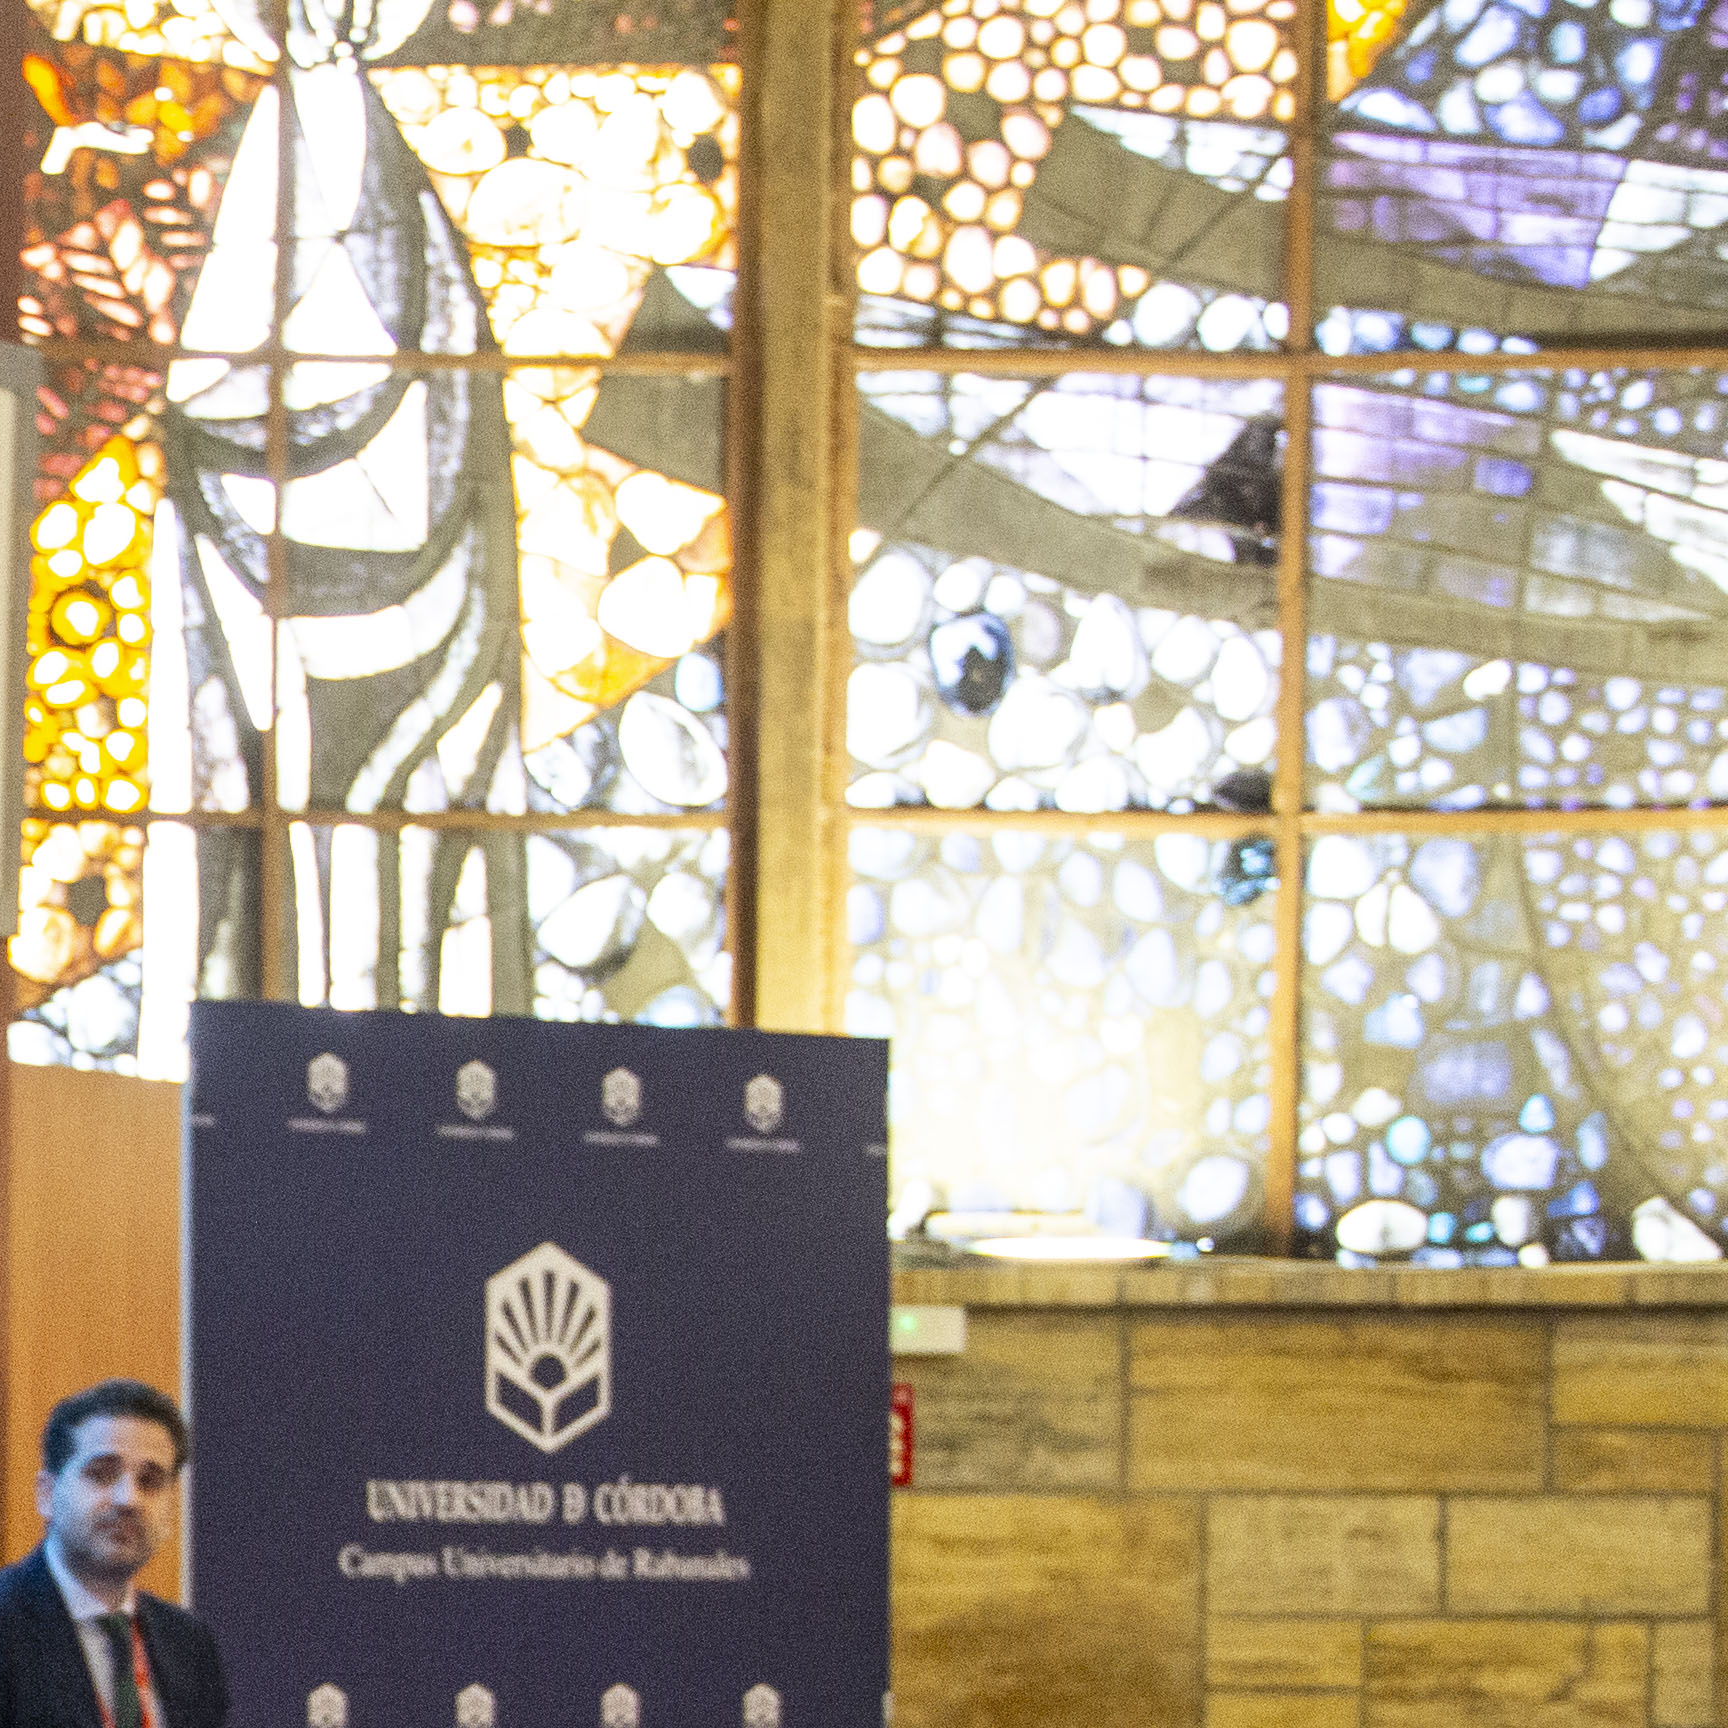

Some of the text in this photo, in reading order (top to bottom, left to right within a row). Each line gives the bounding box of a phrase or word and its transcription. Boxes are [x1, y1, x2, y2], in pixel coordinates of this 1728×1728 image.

[366, 1479, 554, 1525] UNIVERSIDAD
[593, 1473, 726, 1526] CÓRDOBA
[338, 1543, 751, 1588] Campus Universitario de Rabanales
